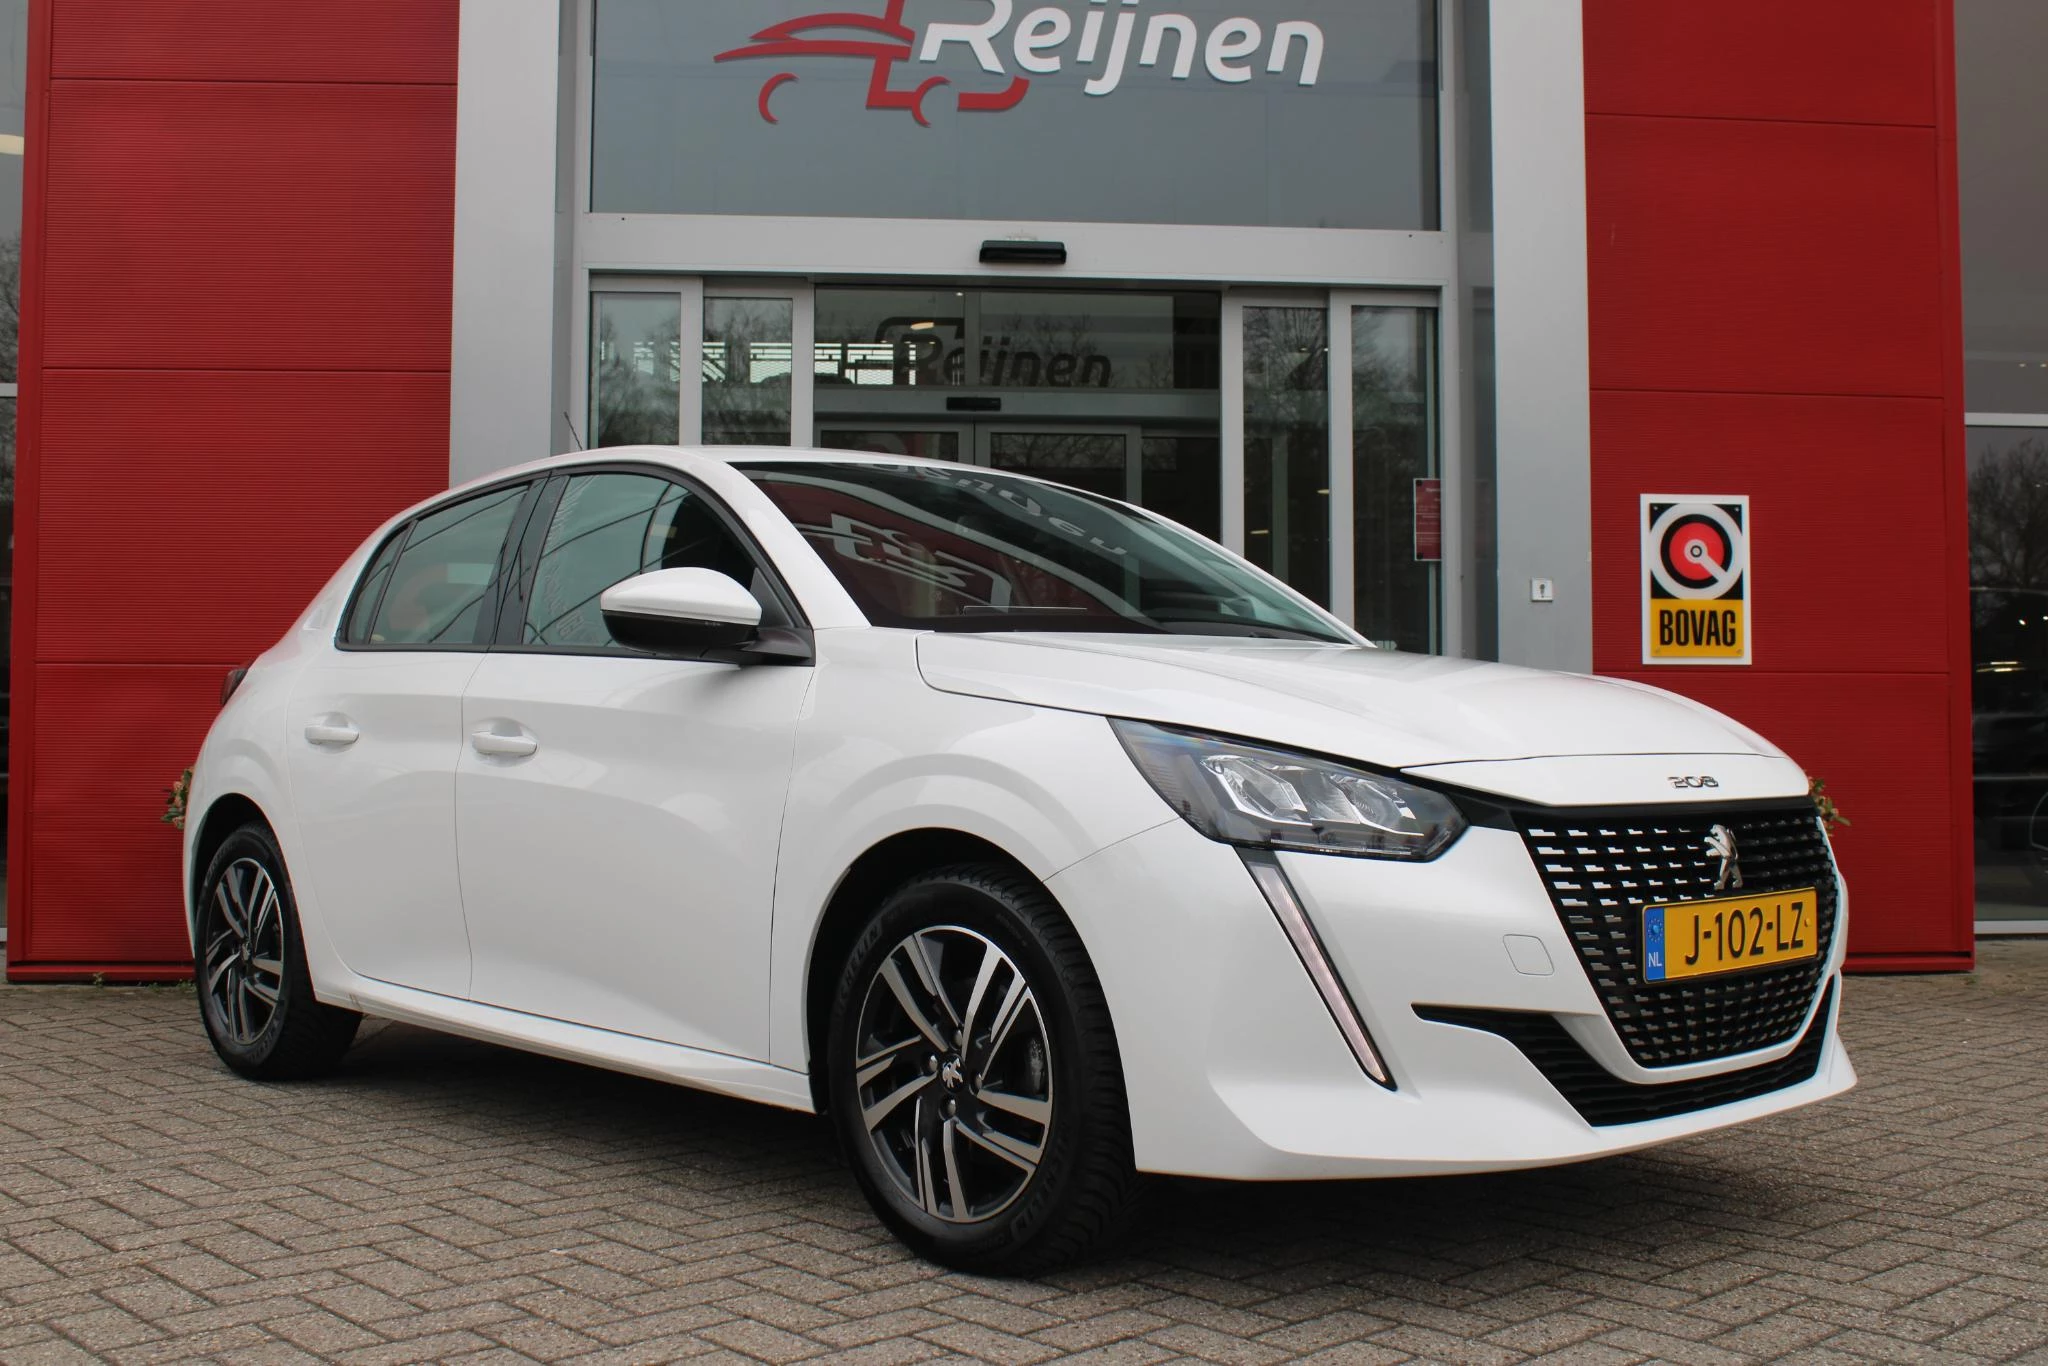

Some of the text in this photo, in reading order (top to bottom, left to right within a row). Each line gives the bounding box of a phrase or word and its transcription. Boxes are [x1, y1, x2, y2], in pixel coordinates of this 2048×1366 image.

[919, 0, 1324, 95] Reijnen
[1660, 609, 1736, 646] BOVAG
[1668, 776, 1719, 788] 208
[1685, 902, 1803, 965] J-102-LZ
[1648, 952, 1662, 967] NL
